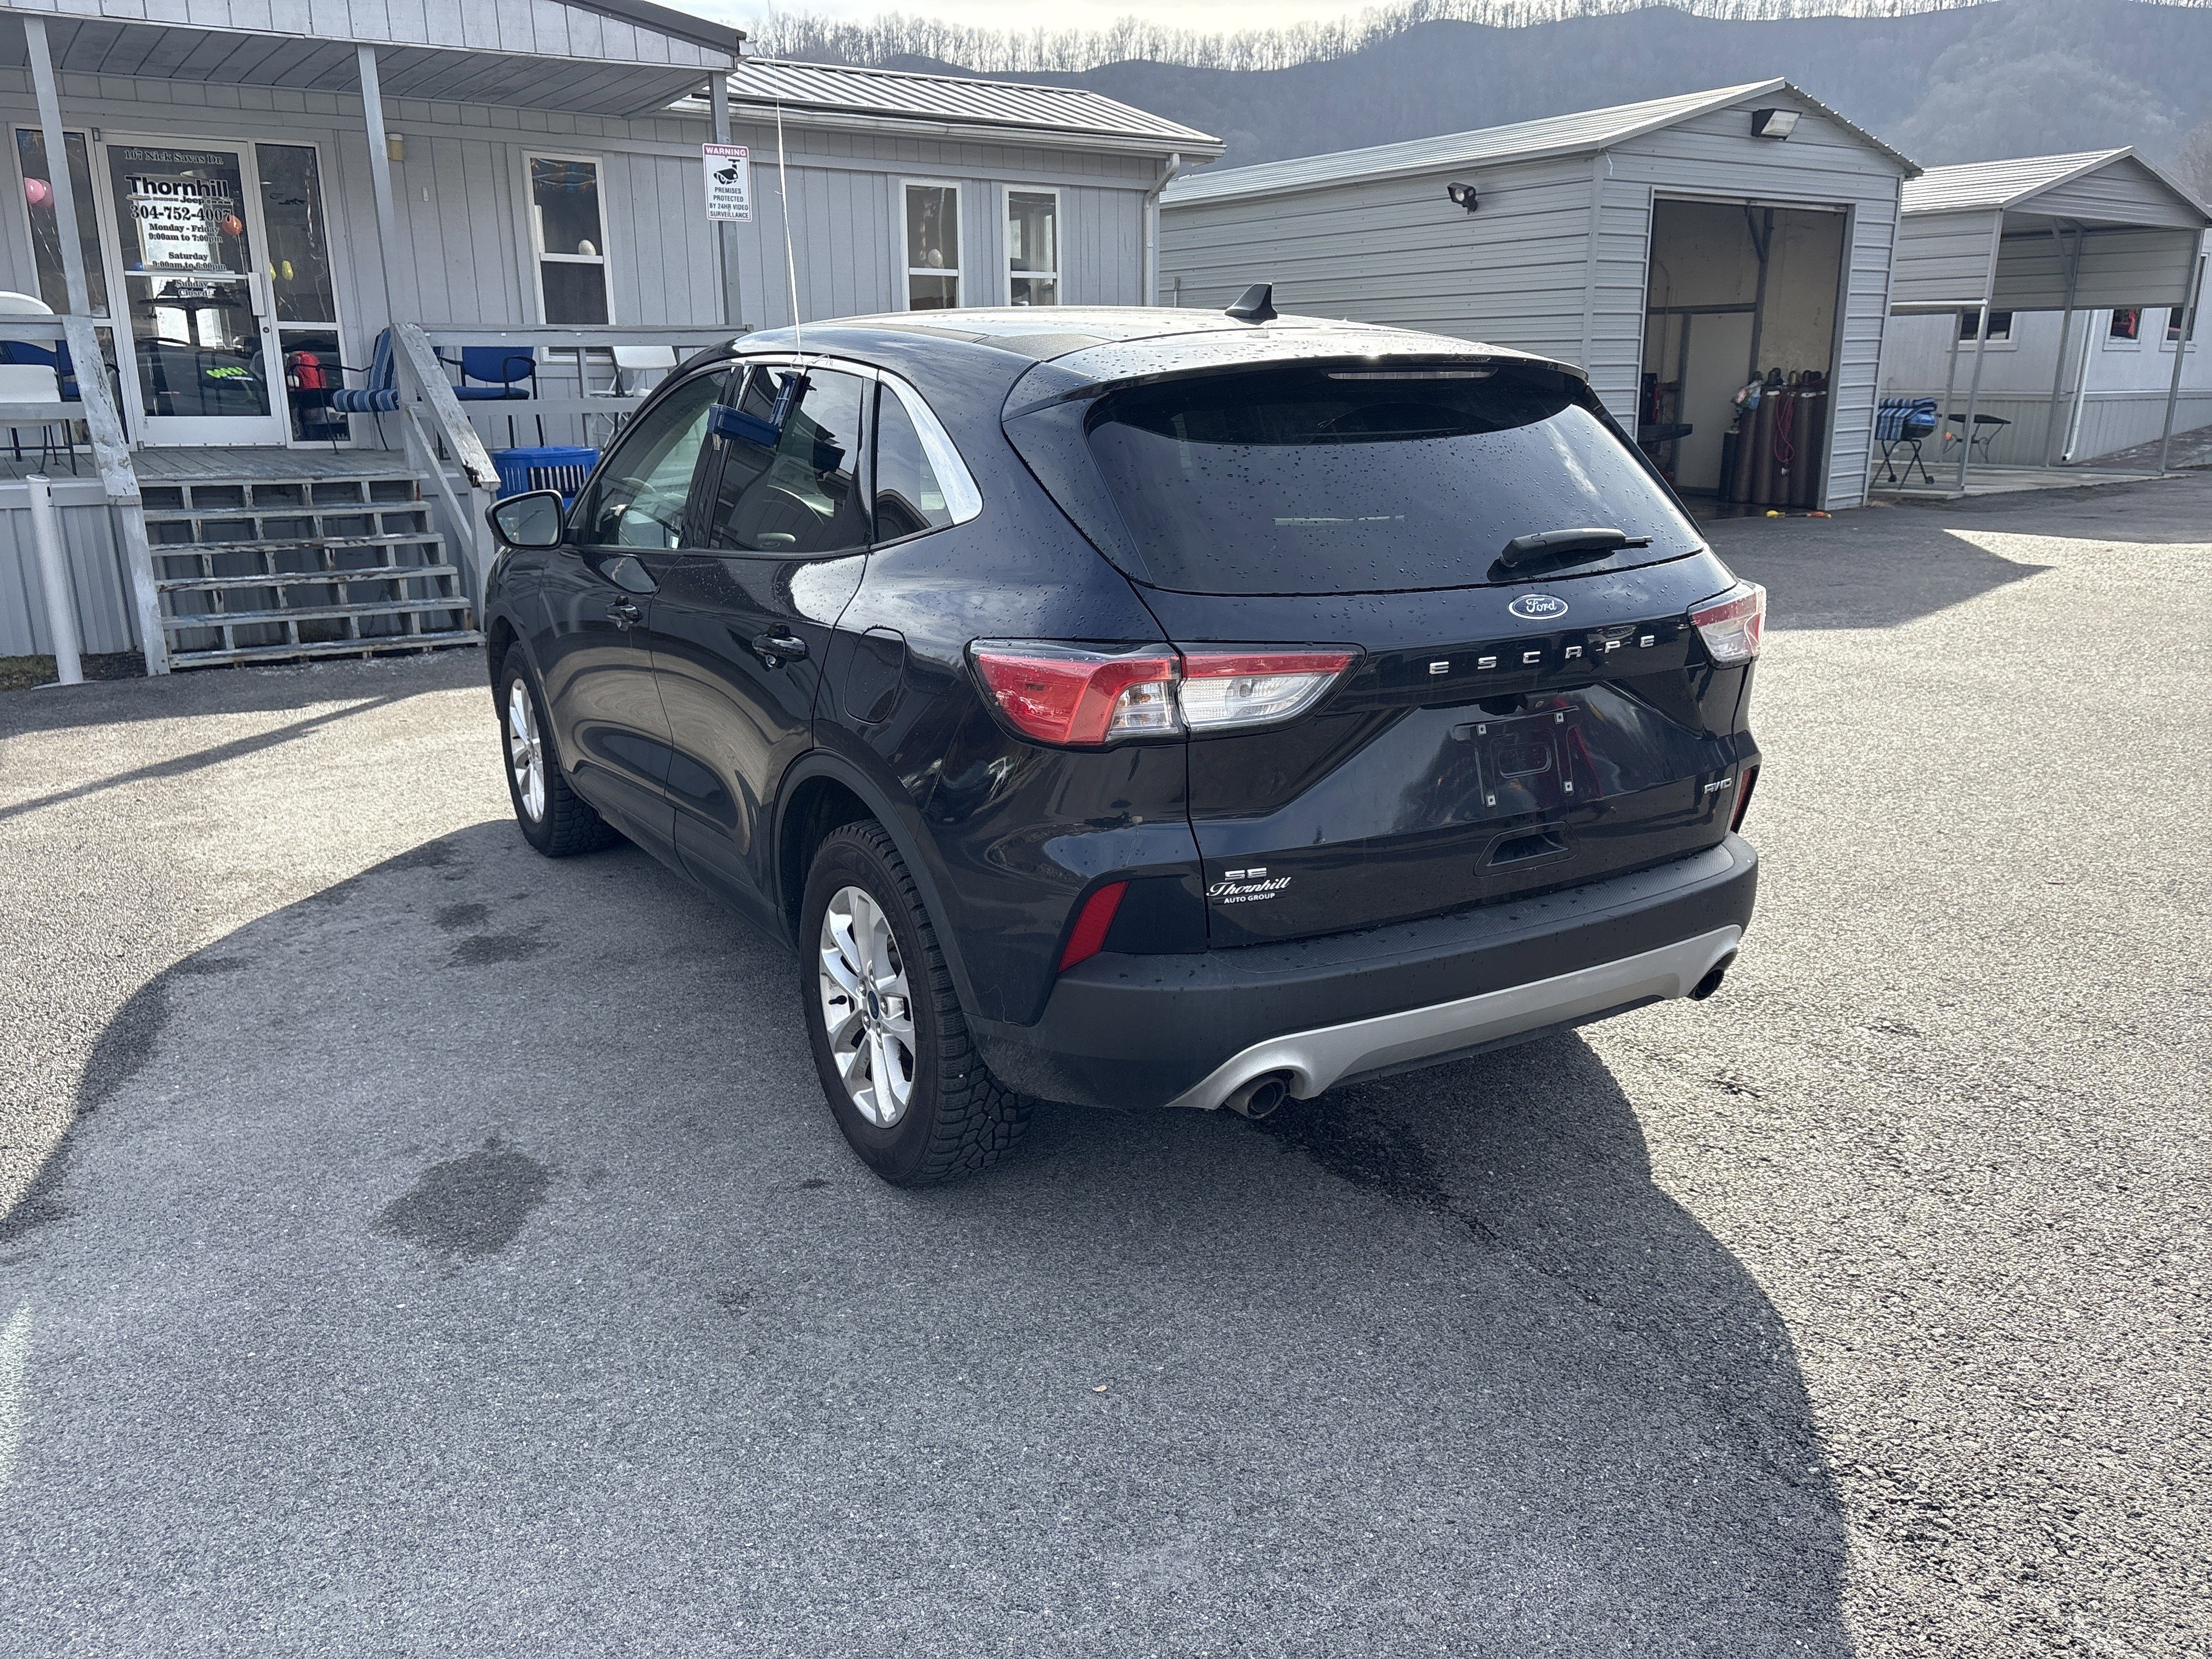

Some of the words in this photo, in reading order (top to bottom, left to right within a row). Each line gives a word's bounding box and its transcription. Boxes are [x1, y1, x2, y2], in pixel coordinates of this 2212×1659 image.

[124, 149, 143, 160] 107
[144, 151, 172, 162] Nick
[173, 153, 206, 164] Savas
[705, 146, 747, 156] WARNING
[125, 176, 229, 198] Thornhill
[180, 196, 204, 205] Jeep
[130, 205, 232, 222] 304-752-4007
[149, 223, 184, 233] Monday
[191, 224, 220, 235] Friday
[148, 232, 179, 241] 9:00am
[191, 234, 223, 243] 7:00pm
[168, 252, 208, 261] Saturday
[153, 261, 183, 269] 9:00am
[176, 280, 208, 289] Sunday
[1525, 597, 1558, 614] Ford
[1429, 635, 1655, 675] ESCAPE
[1703, 777, 1733, 794] AWD
[1224, 867, 1267, 881] SE
[1206, 877, 1291, 896] Thornhill
[1248, 893, 1276, 902] GROUP
